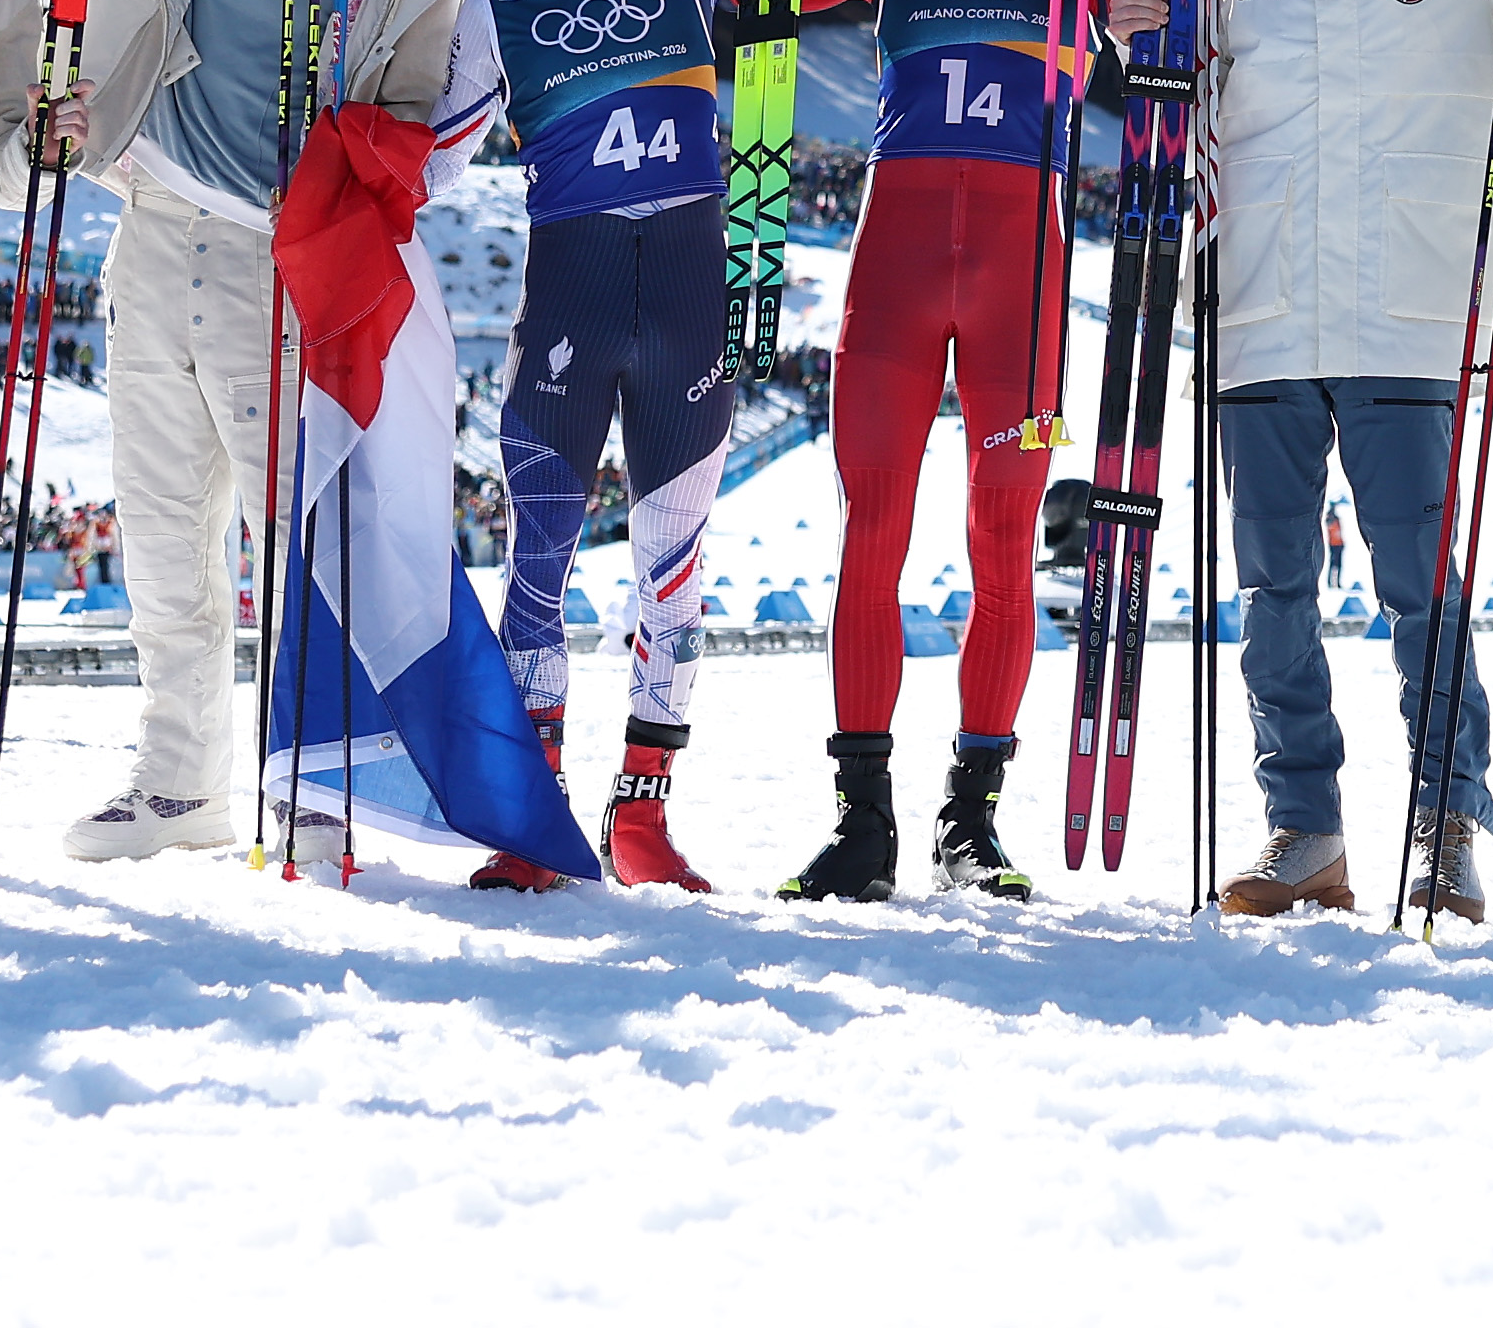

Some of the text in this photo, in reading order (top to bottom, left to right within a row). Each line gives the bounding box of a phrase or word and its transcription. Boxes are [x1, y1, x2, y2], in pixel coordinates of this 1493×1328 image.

[283, 0, 295, 67] LEKI
[309, 3, 321, 72] LEKI
[907, 8, 1051, 27] MILANO CORTINA 202
[542, 43, 688, 91] MILANO CORTINA 2026
[1128, 74, 1192, 92] SALOMON
[725, 298, 744, 369] SPEED
[756, 296, 775, 368] SPEED
[535, 380, 568, 396] FRANCE
[686, 351, 728, 404] CRAF
[1093, 498, 1157, 517] SALOMON
